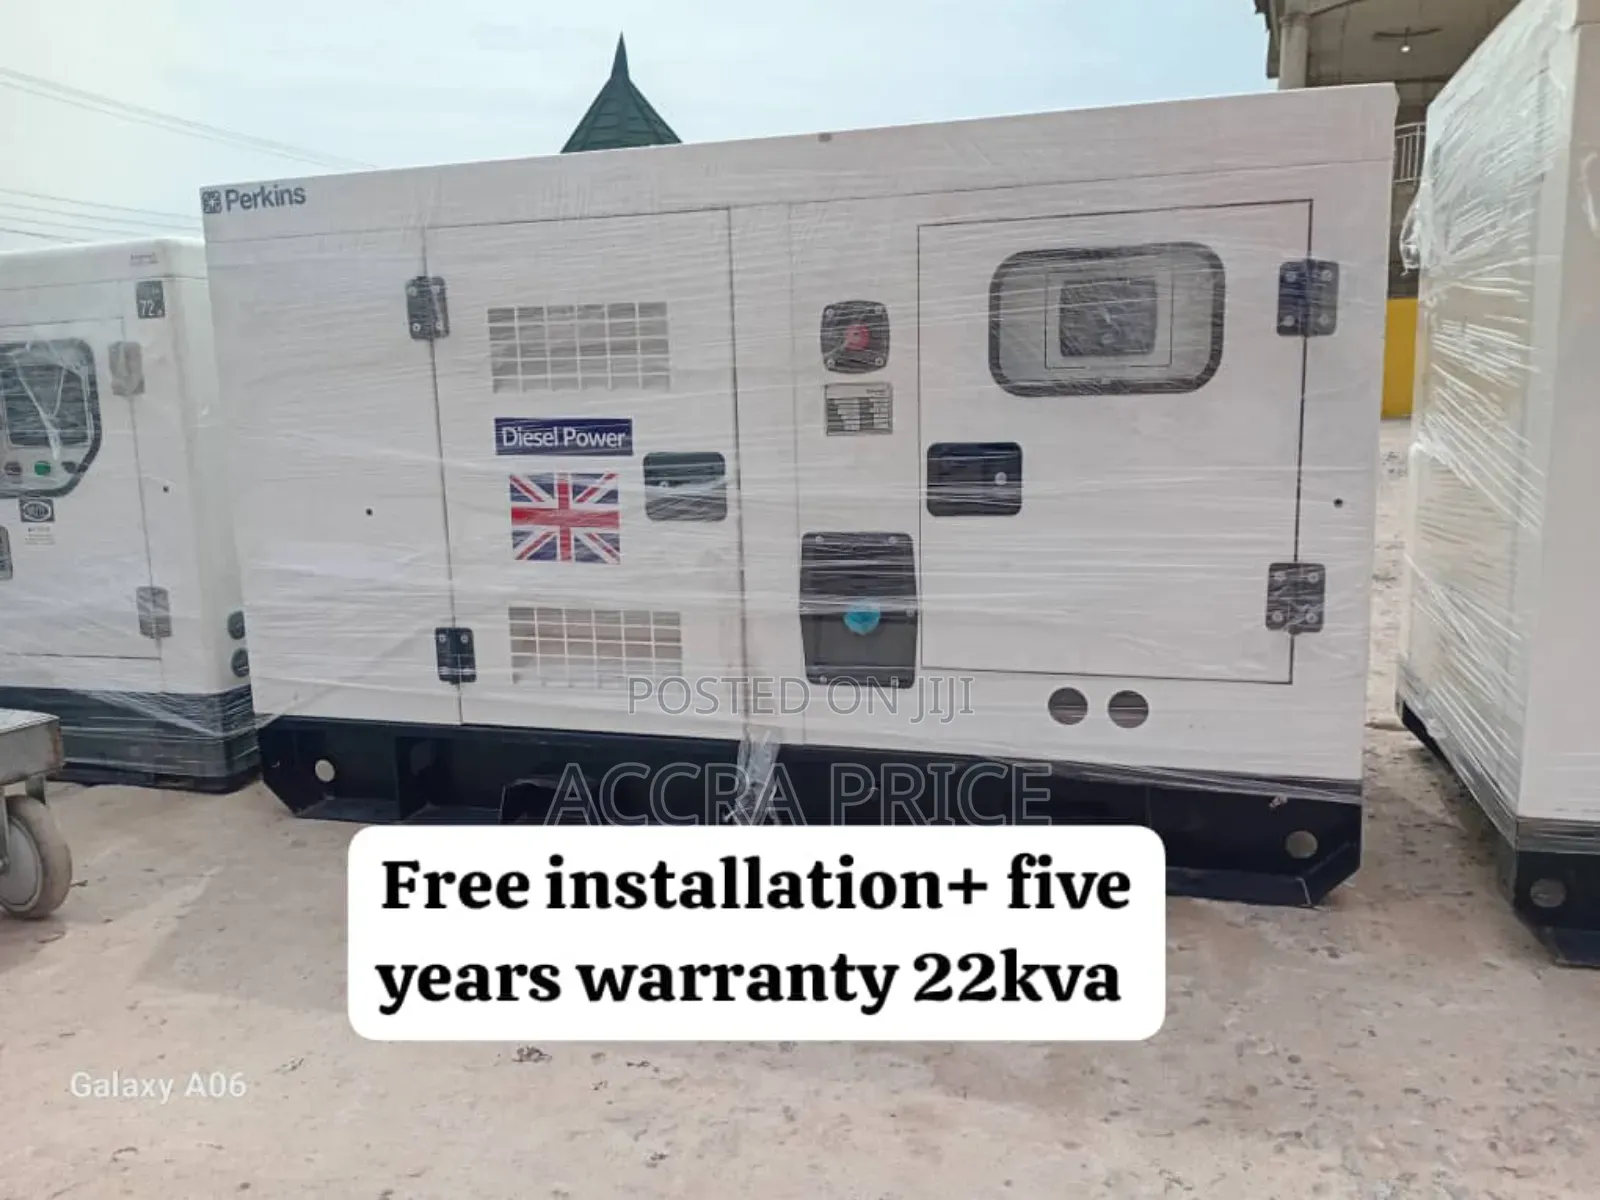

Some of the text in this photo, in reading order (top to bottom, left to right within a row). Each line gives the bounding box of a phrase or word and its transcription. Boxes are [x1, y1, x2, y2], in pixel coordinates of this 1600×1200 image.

[225, 184, 306, 212] Perkins
[502, 426, 626, 447] Diesel Power
